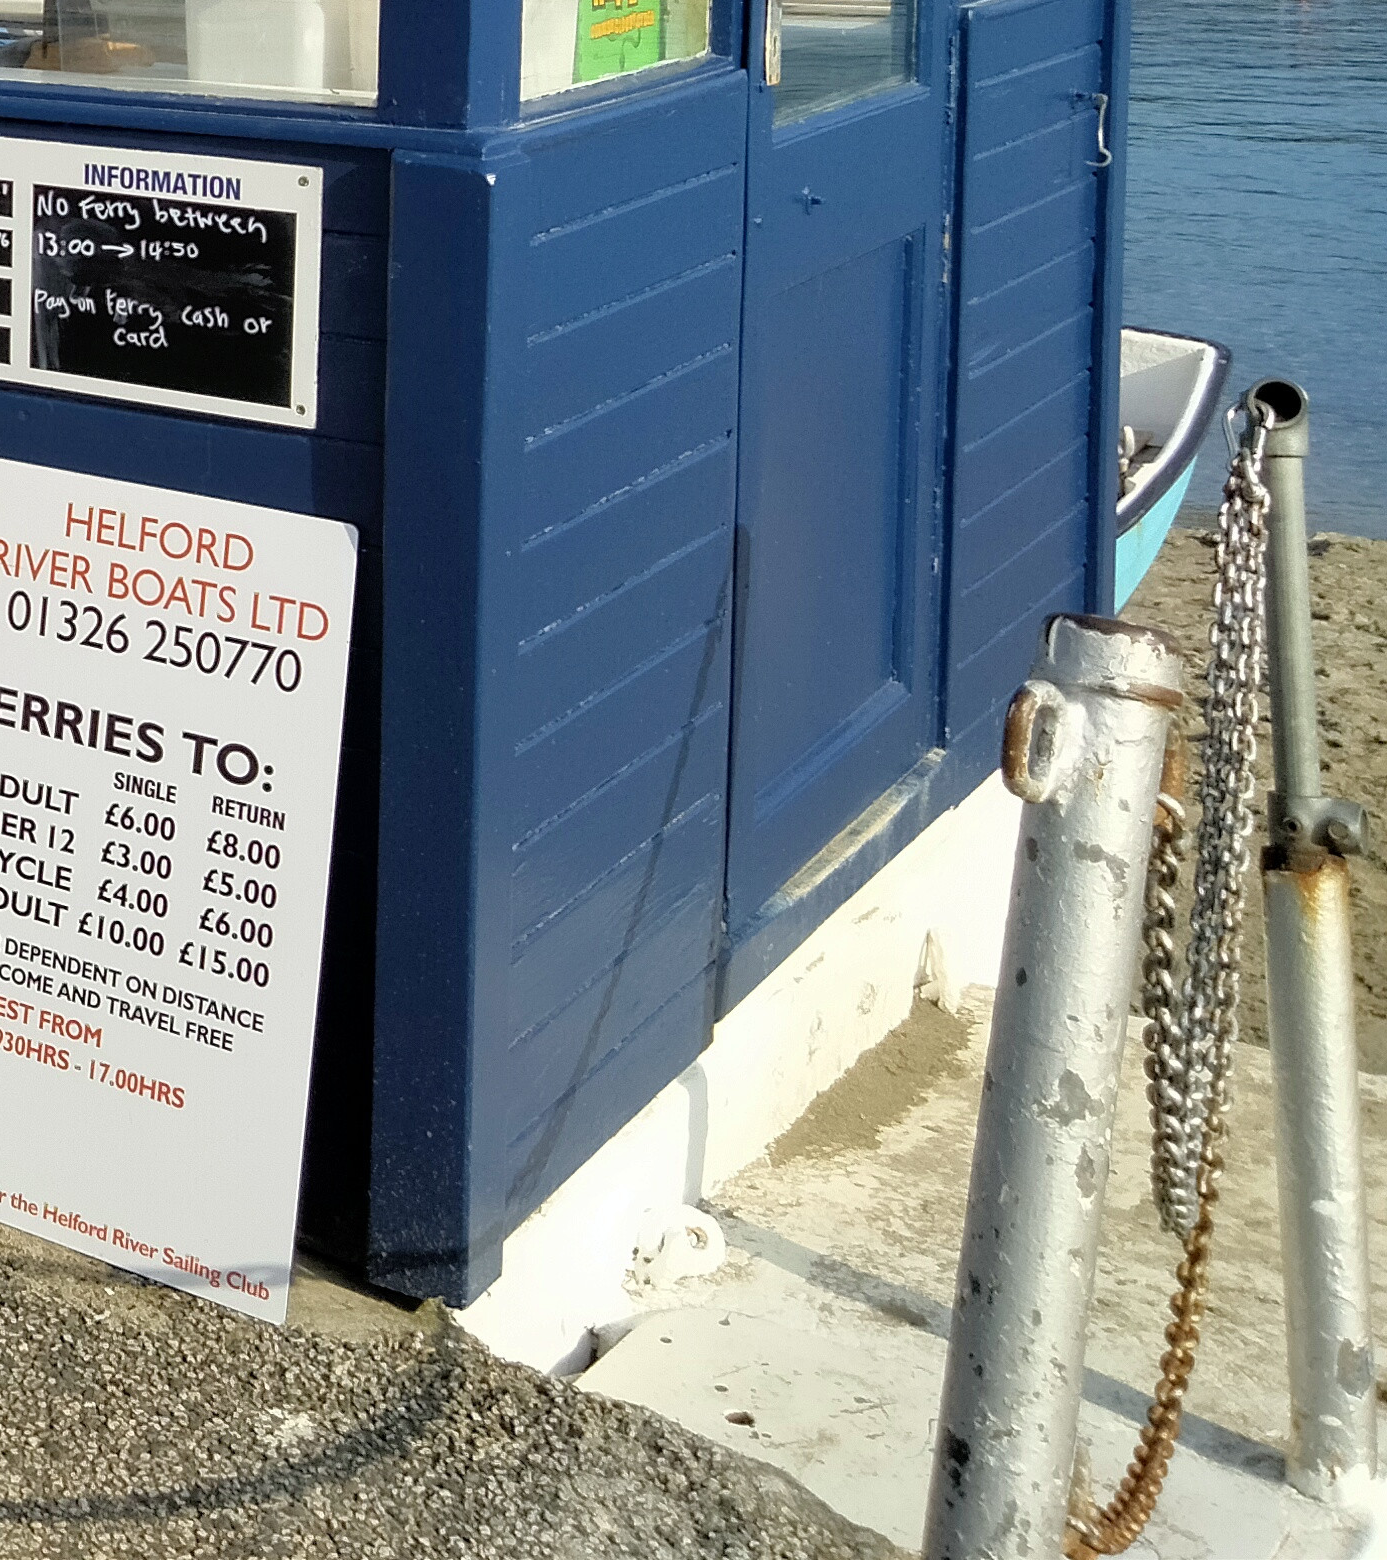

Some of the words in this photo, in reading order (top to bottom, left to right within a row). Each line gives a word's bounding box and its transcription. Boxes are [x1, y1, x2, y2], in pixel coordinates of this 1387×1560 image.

[83, 163, 242, 201] INFORMATION
[37, 231, 96, 257] 13:00
[139, 237, 200, 262] 14:50
[65, 503, 253, 571] HELFORD
[107, 562, 236, 623] BOATS
[251, 592, 329, 641] LTD
[8, 590, 129, 653] 01326
[143, 620, 302, 692] 250770
[182, 731, 274, 792] TO:
[113, 772, 177, 804] SINGLE
[212, 795, 286, 831] RETURN
[49, 825, 74, 854] 12
[101, 841, 172, 879] £3.00
[202, 869, 277, 909] £5.00
[105, 803, 175, 841] £6.00
[206, 830, 280, 869] £8.00
[78, 912, 164, 956] £10.00
[178, 942, 269, 987] £15.00
